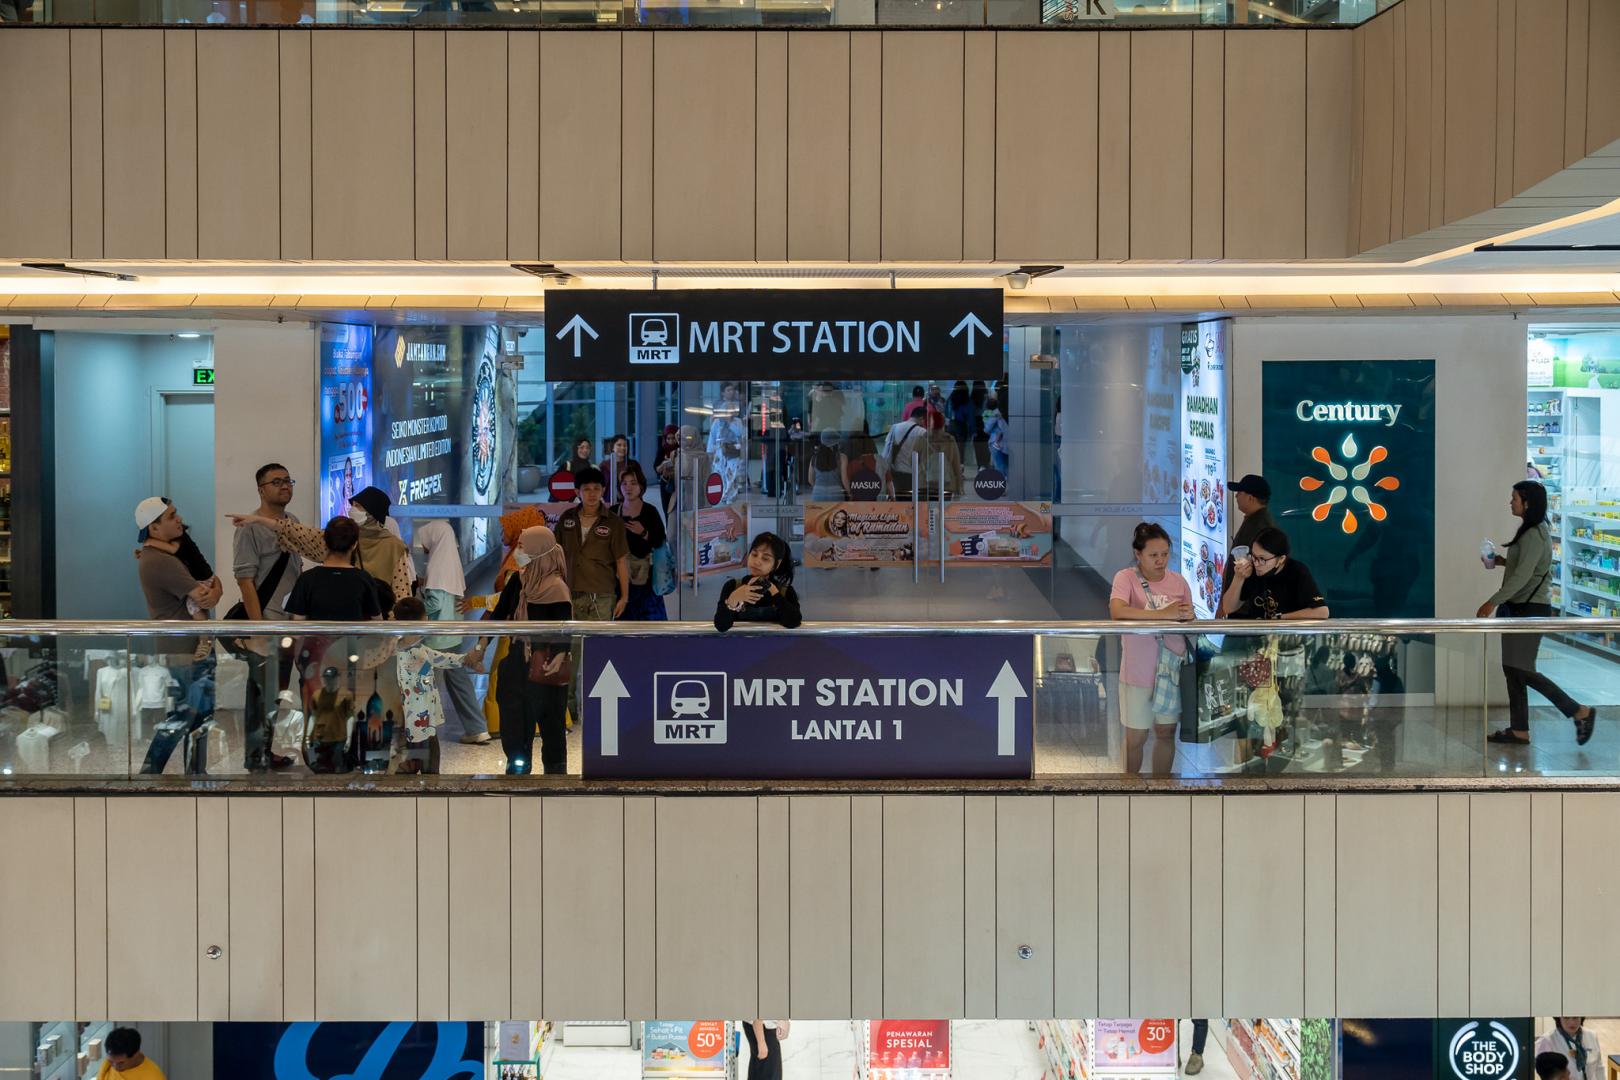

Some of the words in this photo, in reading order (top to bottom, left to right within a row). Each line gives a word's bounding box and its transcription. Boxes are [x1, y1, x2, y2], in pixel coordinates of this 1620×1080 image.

[688, 320, 765, 354] MRT
[772, 320, 921, 354] STATION
[637, 350, 672, 361] MRT
[1186, 395, 1218, 415] RAMADHAN
[1296, 400, 1402, 427] Century
[391, 421, 407, 439] SEIKO
[1189, 419, 1215, 440] SPECIALS
[385, 444, 417, 468] INDONESIAN
[410, 473, 442, 502] PROSPEX
[850, 480, 880, 490] MASUK
[975, 480, 1006, 489] MASUK
[733, 678, 806, 707] MRT
[815, 677, 964, 708] STATION
[664, 724, 716, 740] MRT
[791, 719, 882, 741] LANTAI
[892, 719, 903, 741] 1
[696, 1032, 722, 1047] 50%
[1146, 1026, 1171, 1041] 30%
[886, 1039, 933, 1048] SPESIAL
[1472, 1041, 1497, 1051] THE
[1462, 1051, 1507, 1063] BODY
[1465, 1063, 1505, 1075] SHOP
